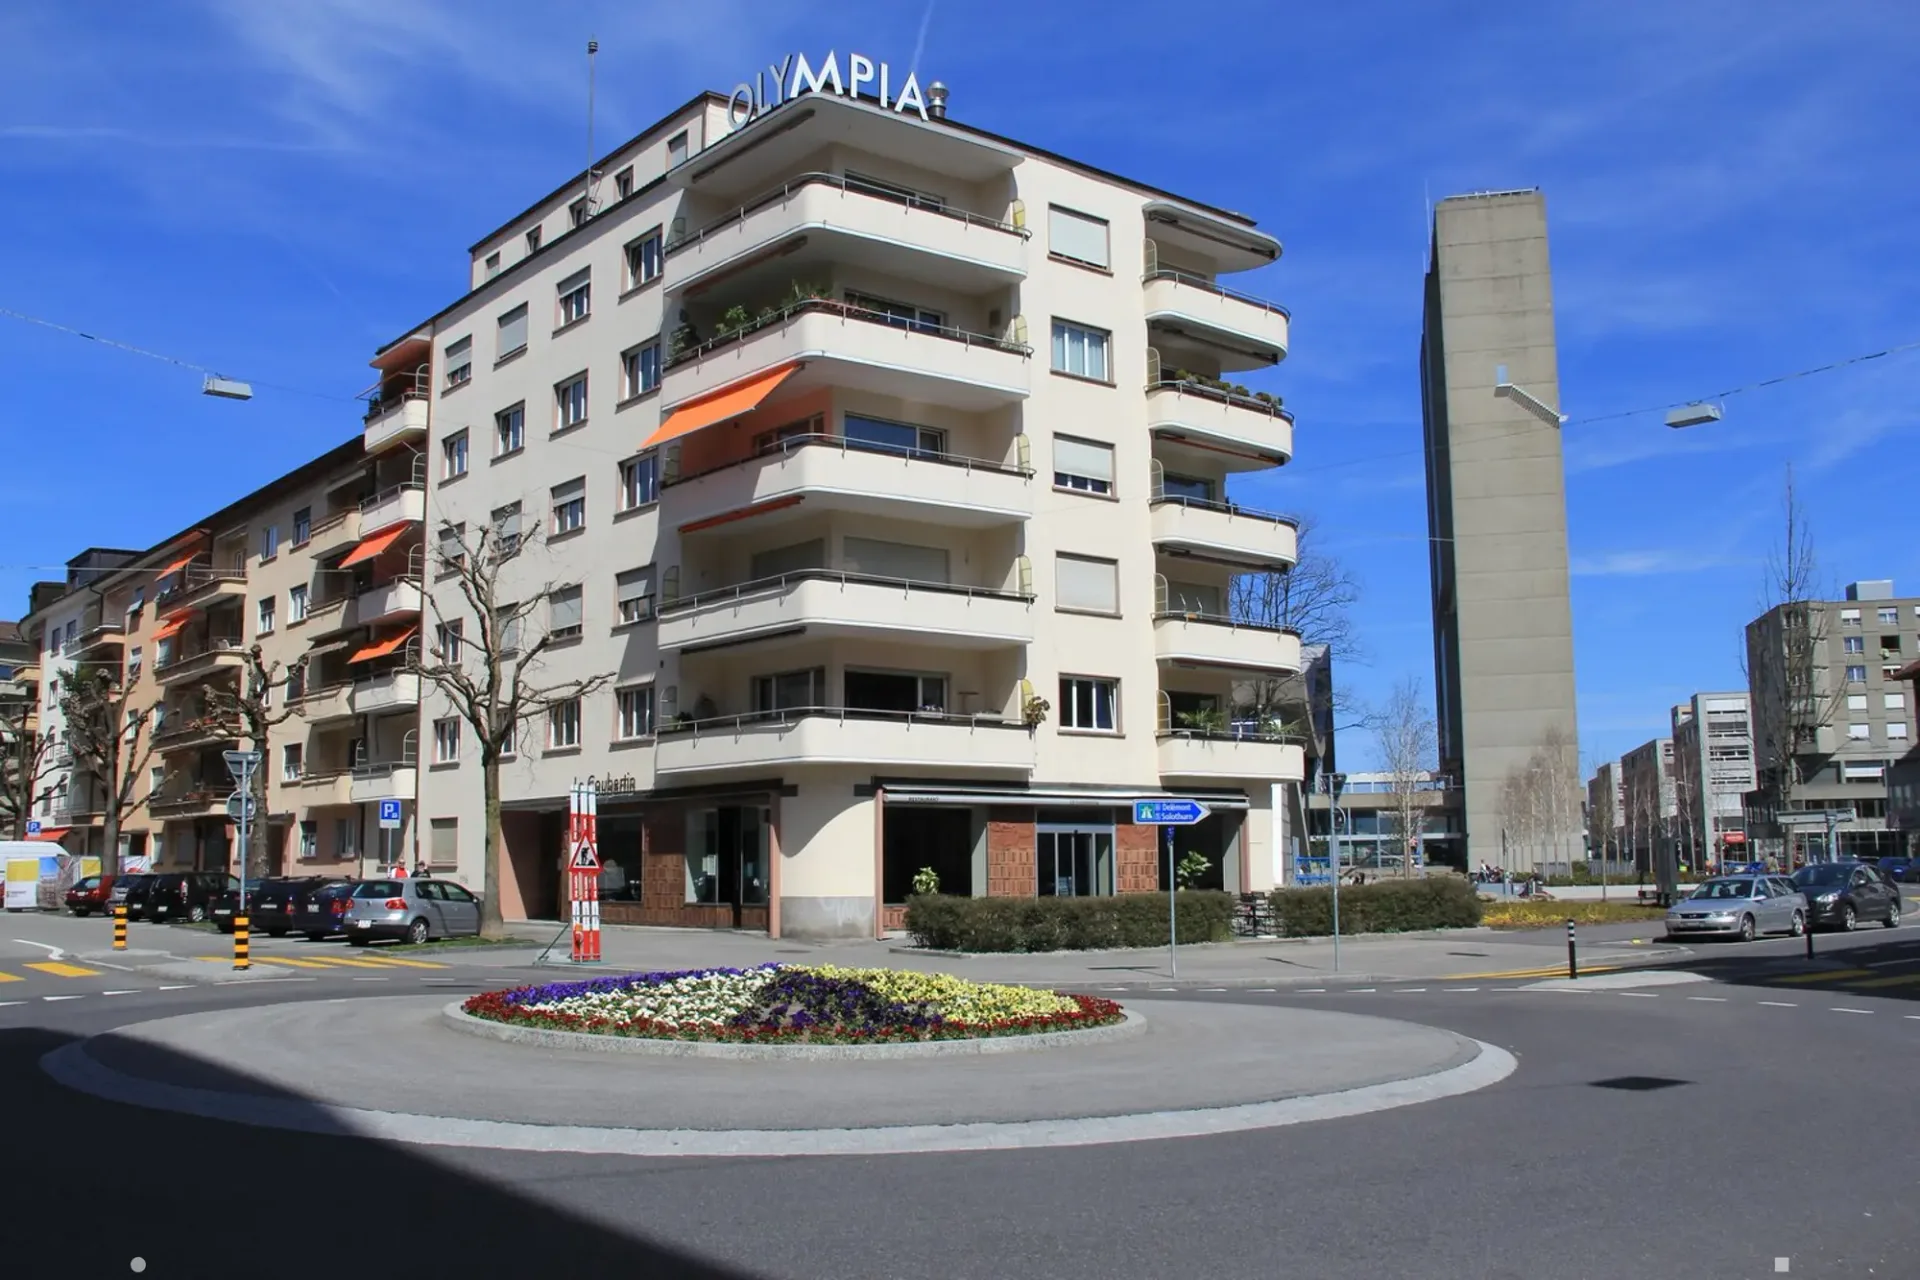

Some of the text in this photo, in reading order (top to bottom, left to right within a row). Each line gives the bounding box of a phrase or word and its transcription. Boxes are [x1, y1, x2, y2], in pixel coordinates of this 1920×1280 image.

[727, 50, 929, 131] OLYMPIA
[384, 803, 394, 817] P
[1162, 812, 1193, 820] Solothurn
